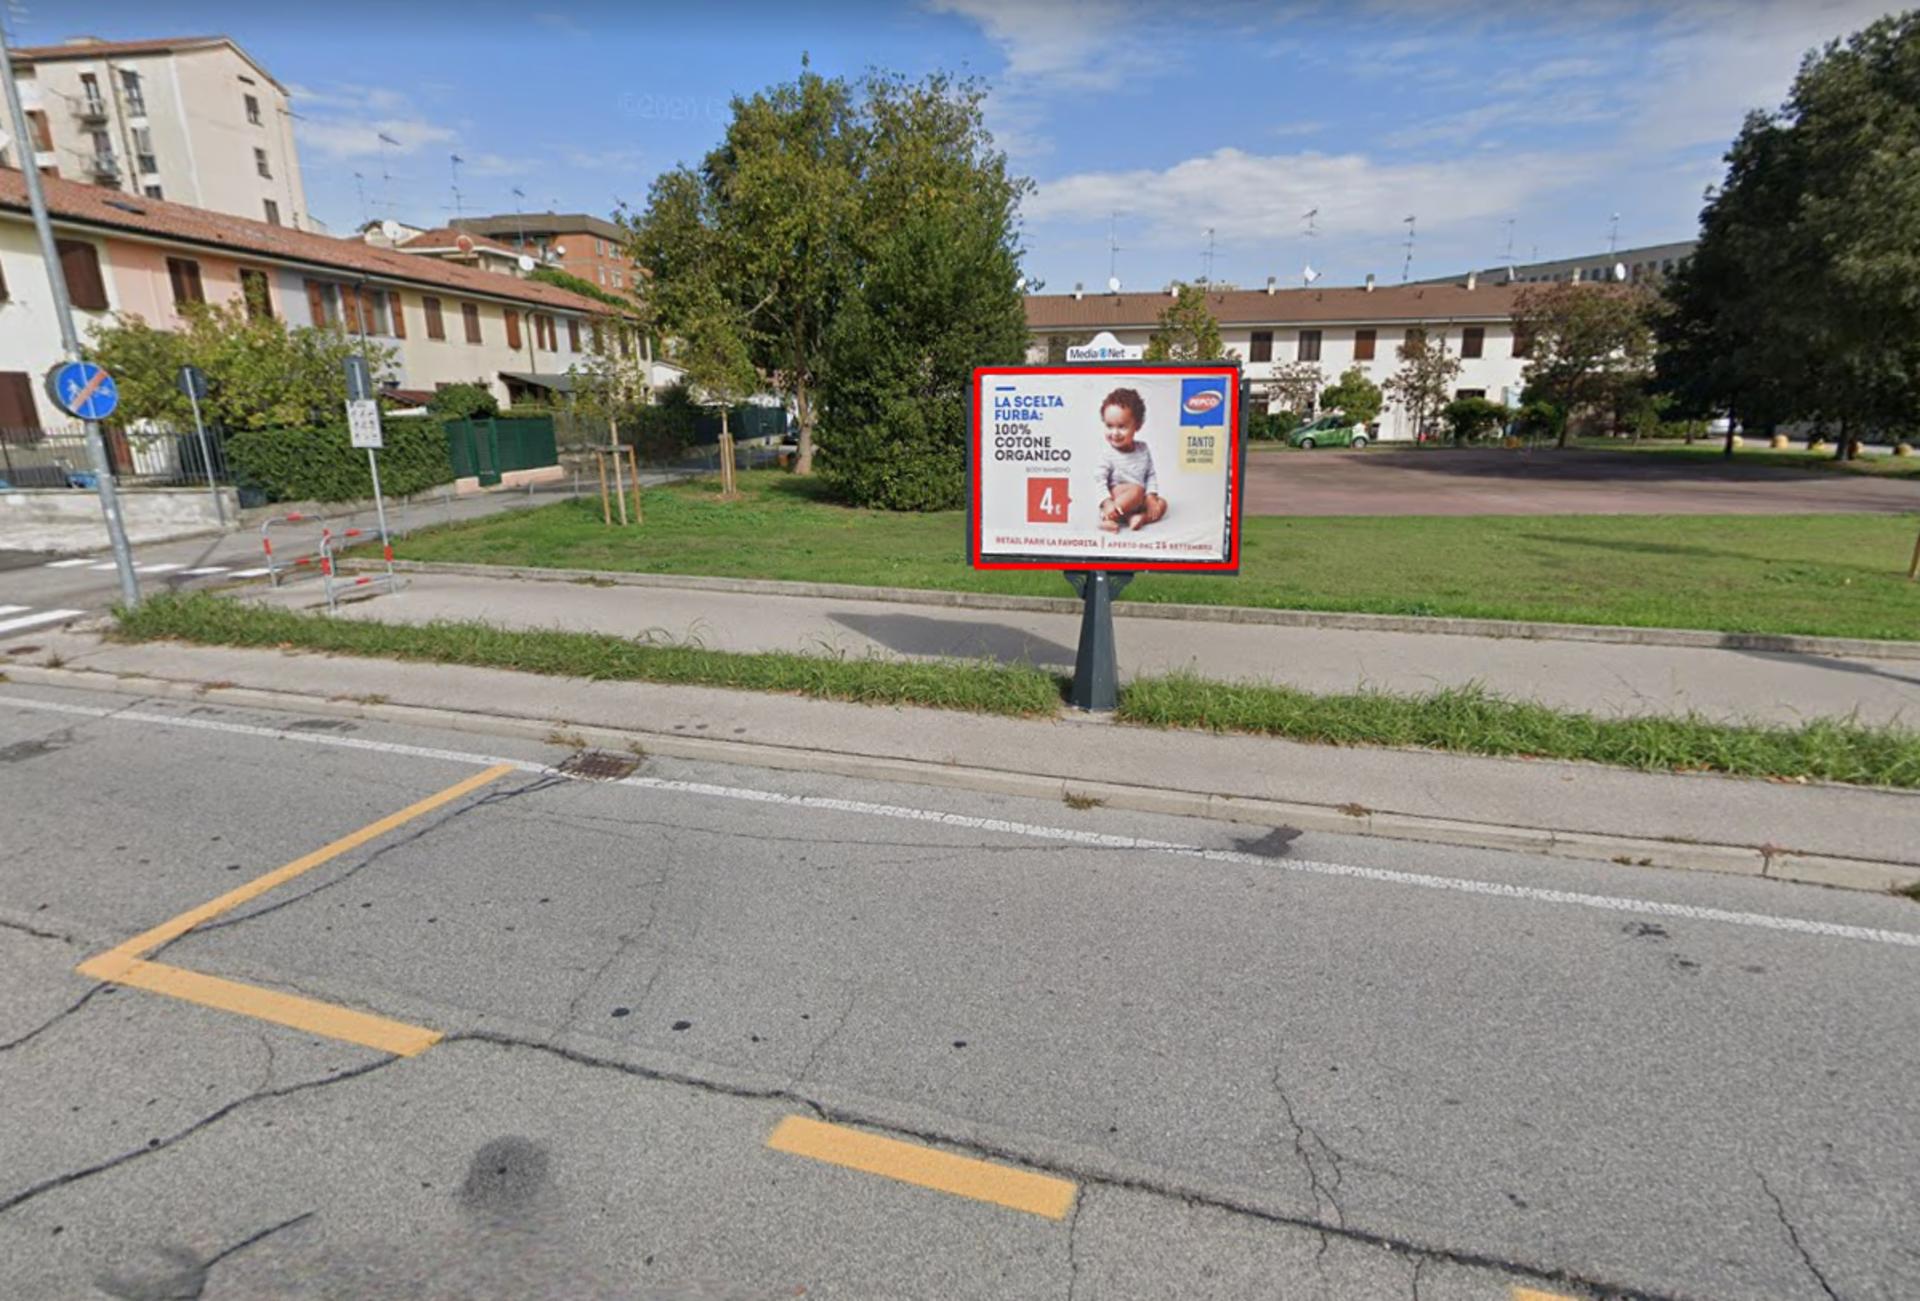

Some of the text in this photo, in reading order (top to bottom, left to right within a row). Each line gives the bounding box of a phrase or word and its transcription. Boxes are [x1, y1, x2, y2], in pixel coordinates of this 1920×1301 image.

[994, 395, 1064, 408] LA SCELTA
[994, 409, 1044, 421] FURBA:
[995, 423, 1031, 435] 100%
[995, 436, 1052, 448] COTONE
[1187, 435, 1214, 448] TANTO
[995, 449, 1072, 462] ORGANICO
[995, 535, 1098, 548] RETAIL PARK LA FAVORITA
[1107, 539, 1137, 549] APERTO
